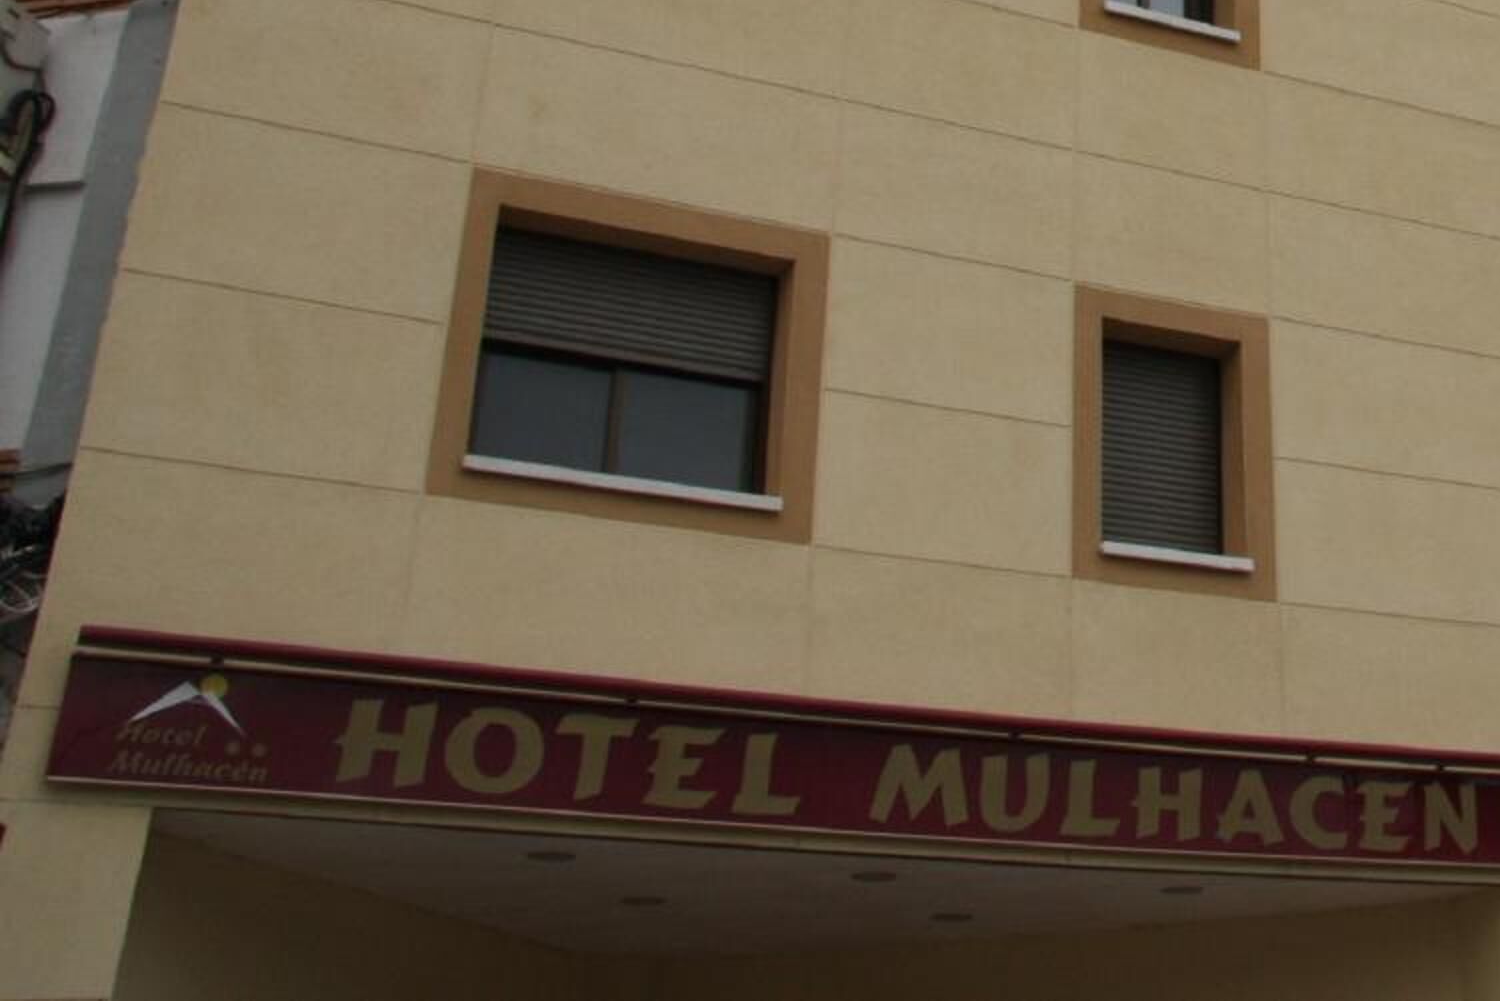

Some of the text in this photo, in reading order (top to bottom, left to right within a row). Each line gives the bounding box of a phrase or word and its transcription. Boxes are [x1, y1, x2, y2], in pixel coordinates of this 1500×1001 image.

[115, 721, 207, 745] Hotel
[336, 699, 1479, 854] HOTEL MULHACEN
